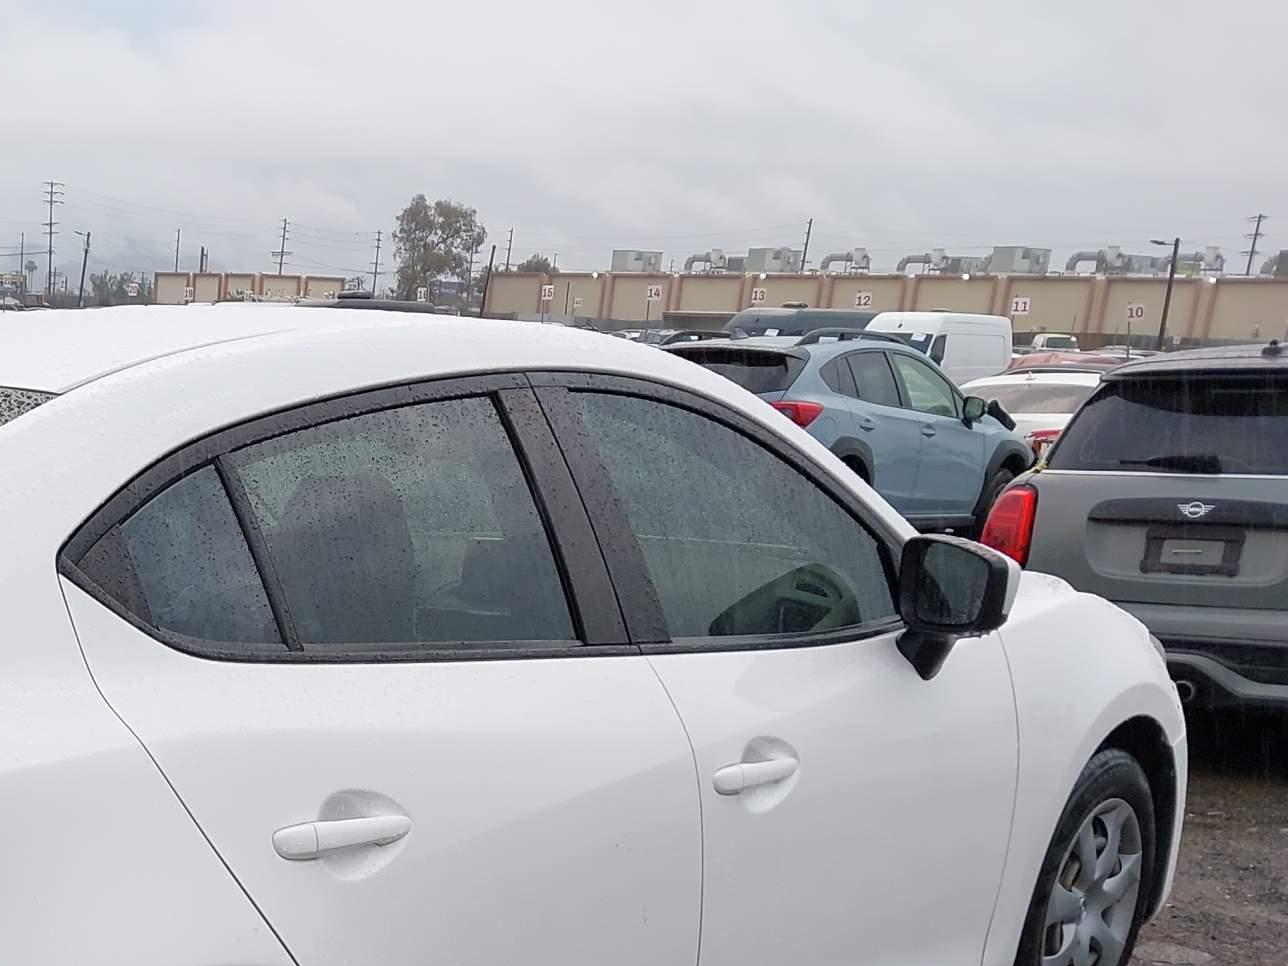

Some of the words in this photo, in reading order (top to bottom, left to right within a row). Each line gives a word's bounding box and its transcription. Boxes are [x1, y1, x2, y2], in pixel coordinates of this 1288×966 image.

[542, 287, 553, 298] 15
[648, 288, 660, 298] 14
[753, 290, 765, 301] 13
[856, 295, 871, 306] 12
[1013, 301, 1028, 312] 11
[1127, 307, 1144, 319] 10
